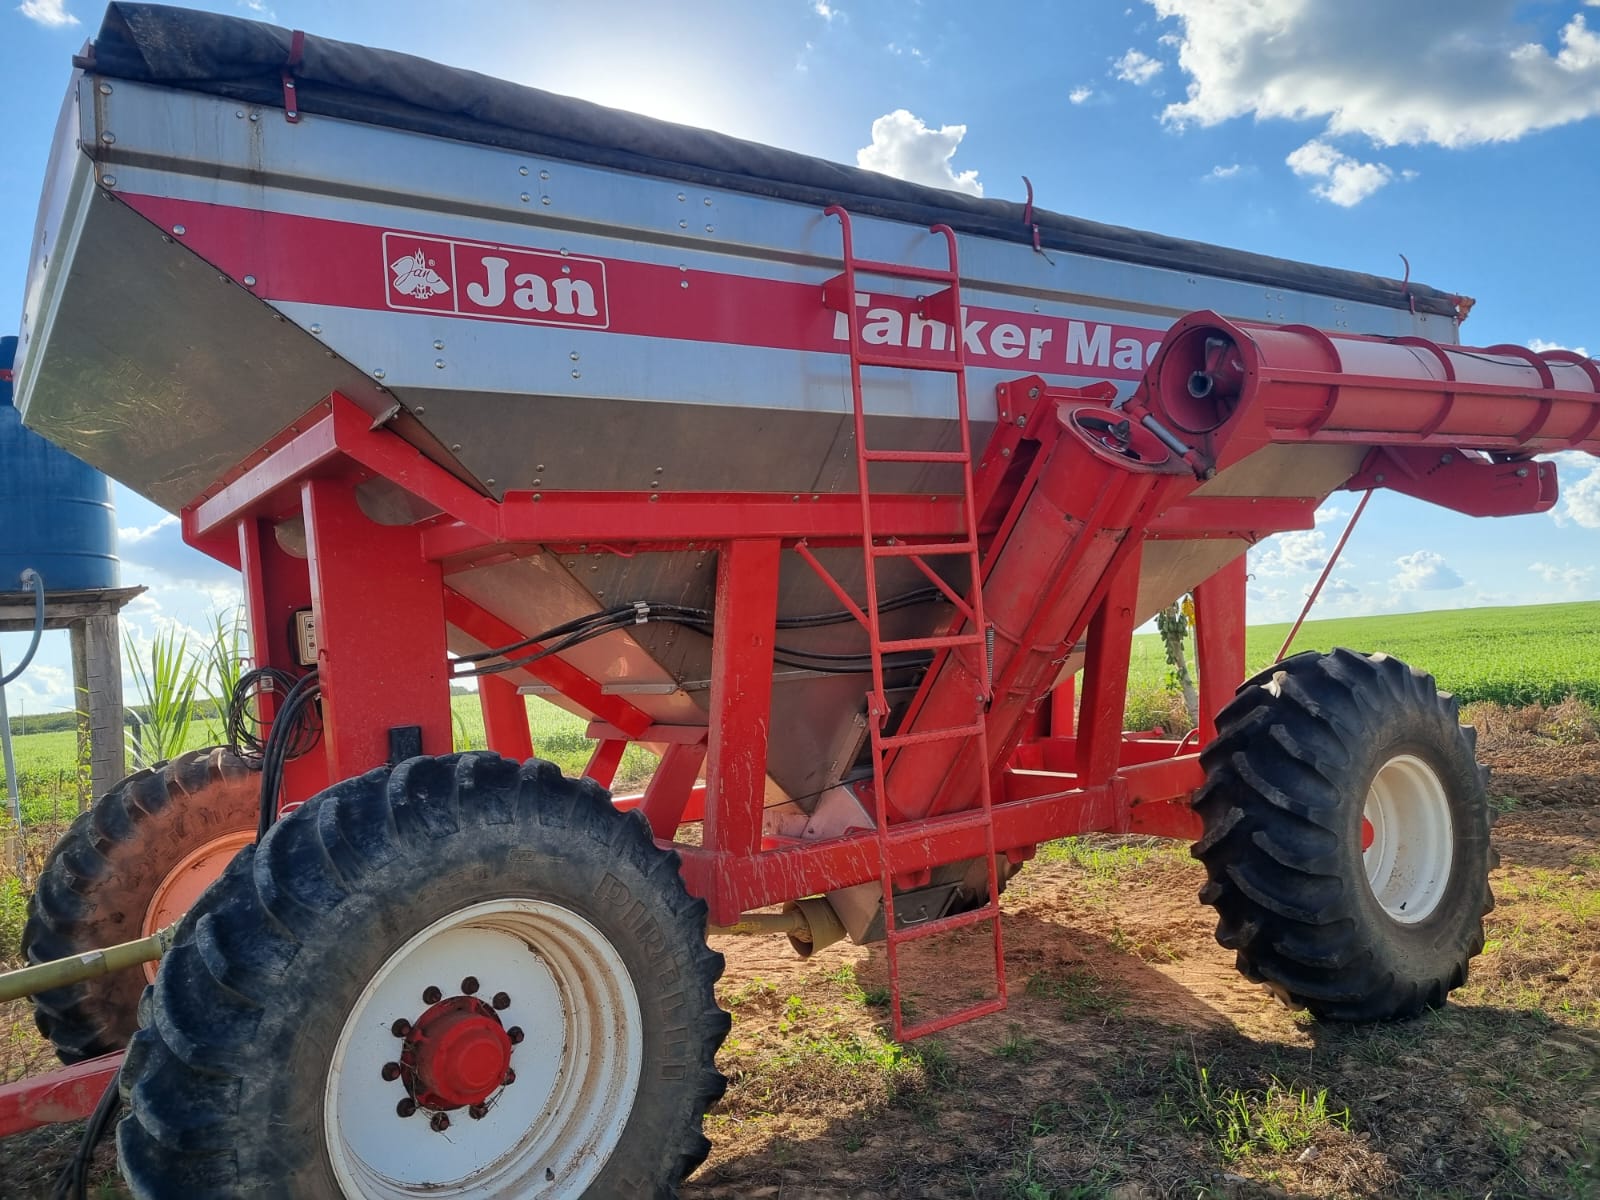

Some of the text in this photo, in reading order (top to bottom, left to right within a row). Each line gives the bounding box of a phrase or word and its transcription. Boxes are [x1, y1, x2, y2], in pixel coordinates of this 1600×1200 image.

[392, 256, 441, 286] Jan
[466, 256, 599, 317] Jan
[592, 872, 690, 1080] PIRELLI
